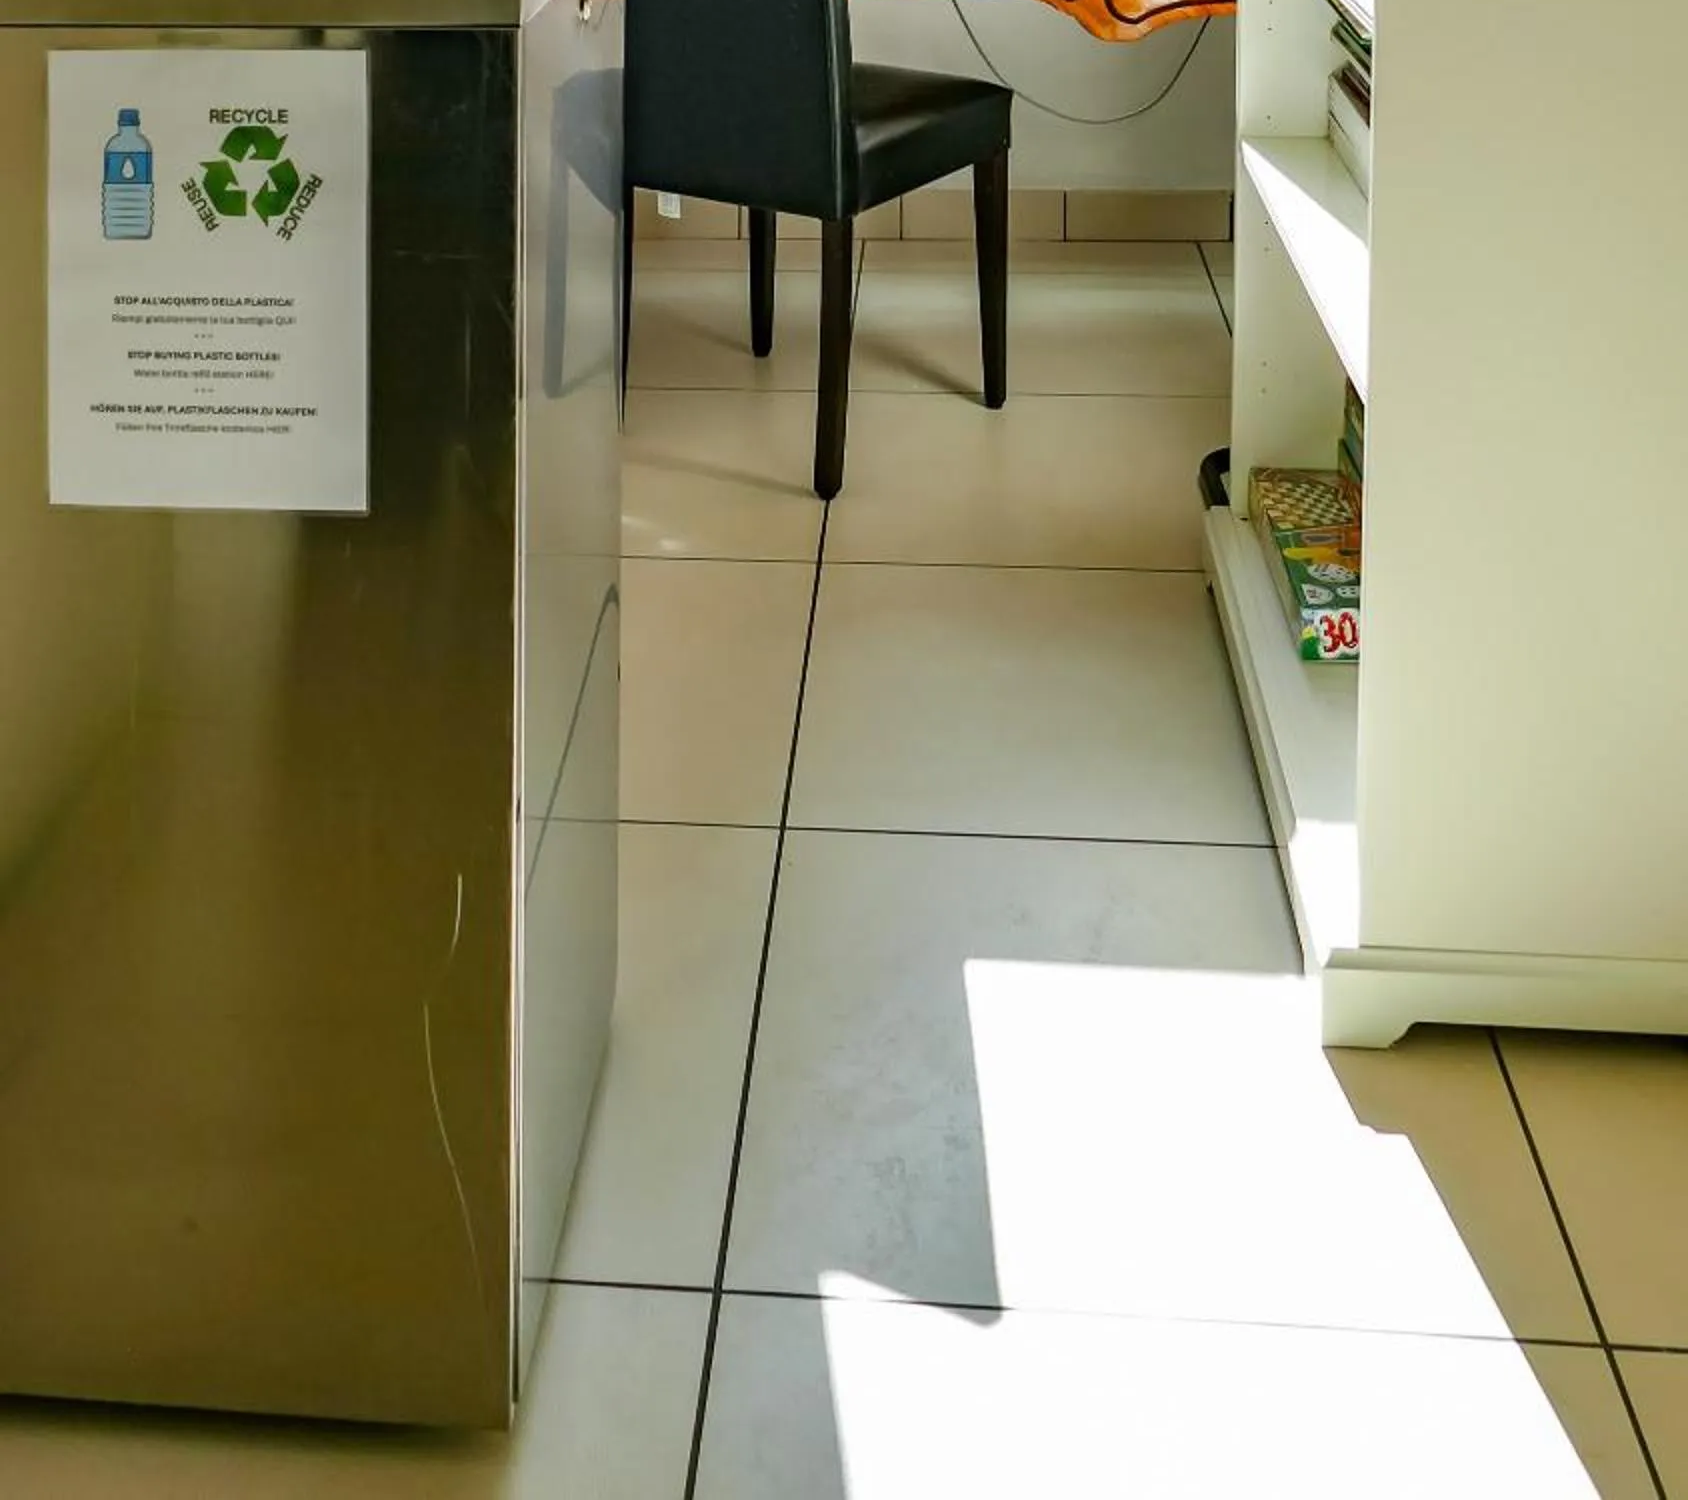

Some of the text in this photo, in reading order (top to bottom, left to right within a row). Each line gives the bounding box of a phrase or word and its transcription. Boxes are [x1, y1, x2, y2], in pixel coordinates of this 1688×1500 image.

[208, 108, 289, 124] RECYCLE
[180, 176, 220, 232] REUSE
[275, 173, 324, 242] REDUCE
[113, 296, 139, 305] STOP
[141, 296, 210, 306] ALL'ACQUISTO
[211, 297, 242, 306] DELLA
[127, 351, 152, 359] STOP
[153, 351, 192, 360] BUYING
[193, 352, 233, 360] PLASTIC
[89, 404, 125, 413] HÖREN
[127, 404, 142, 414] SIE
[168, 405, 259, 415] PLASTIKFLASCHEN
[260, 406, 274, 415] ZU
[1318, 611, 1359, 653] 30
